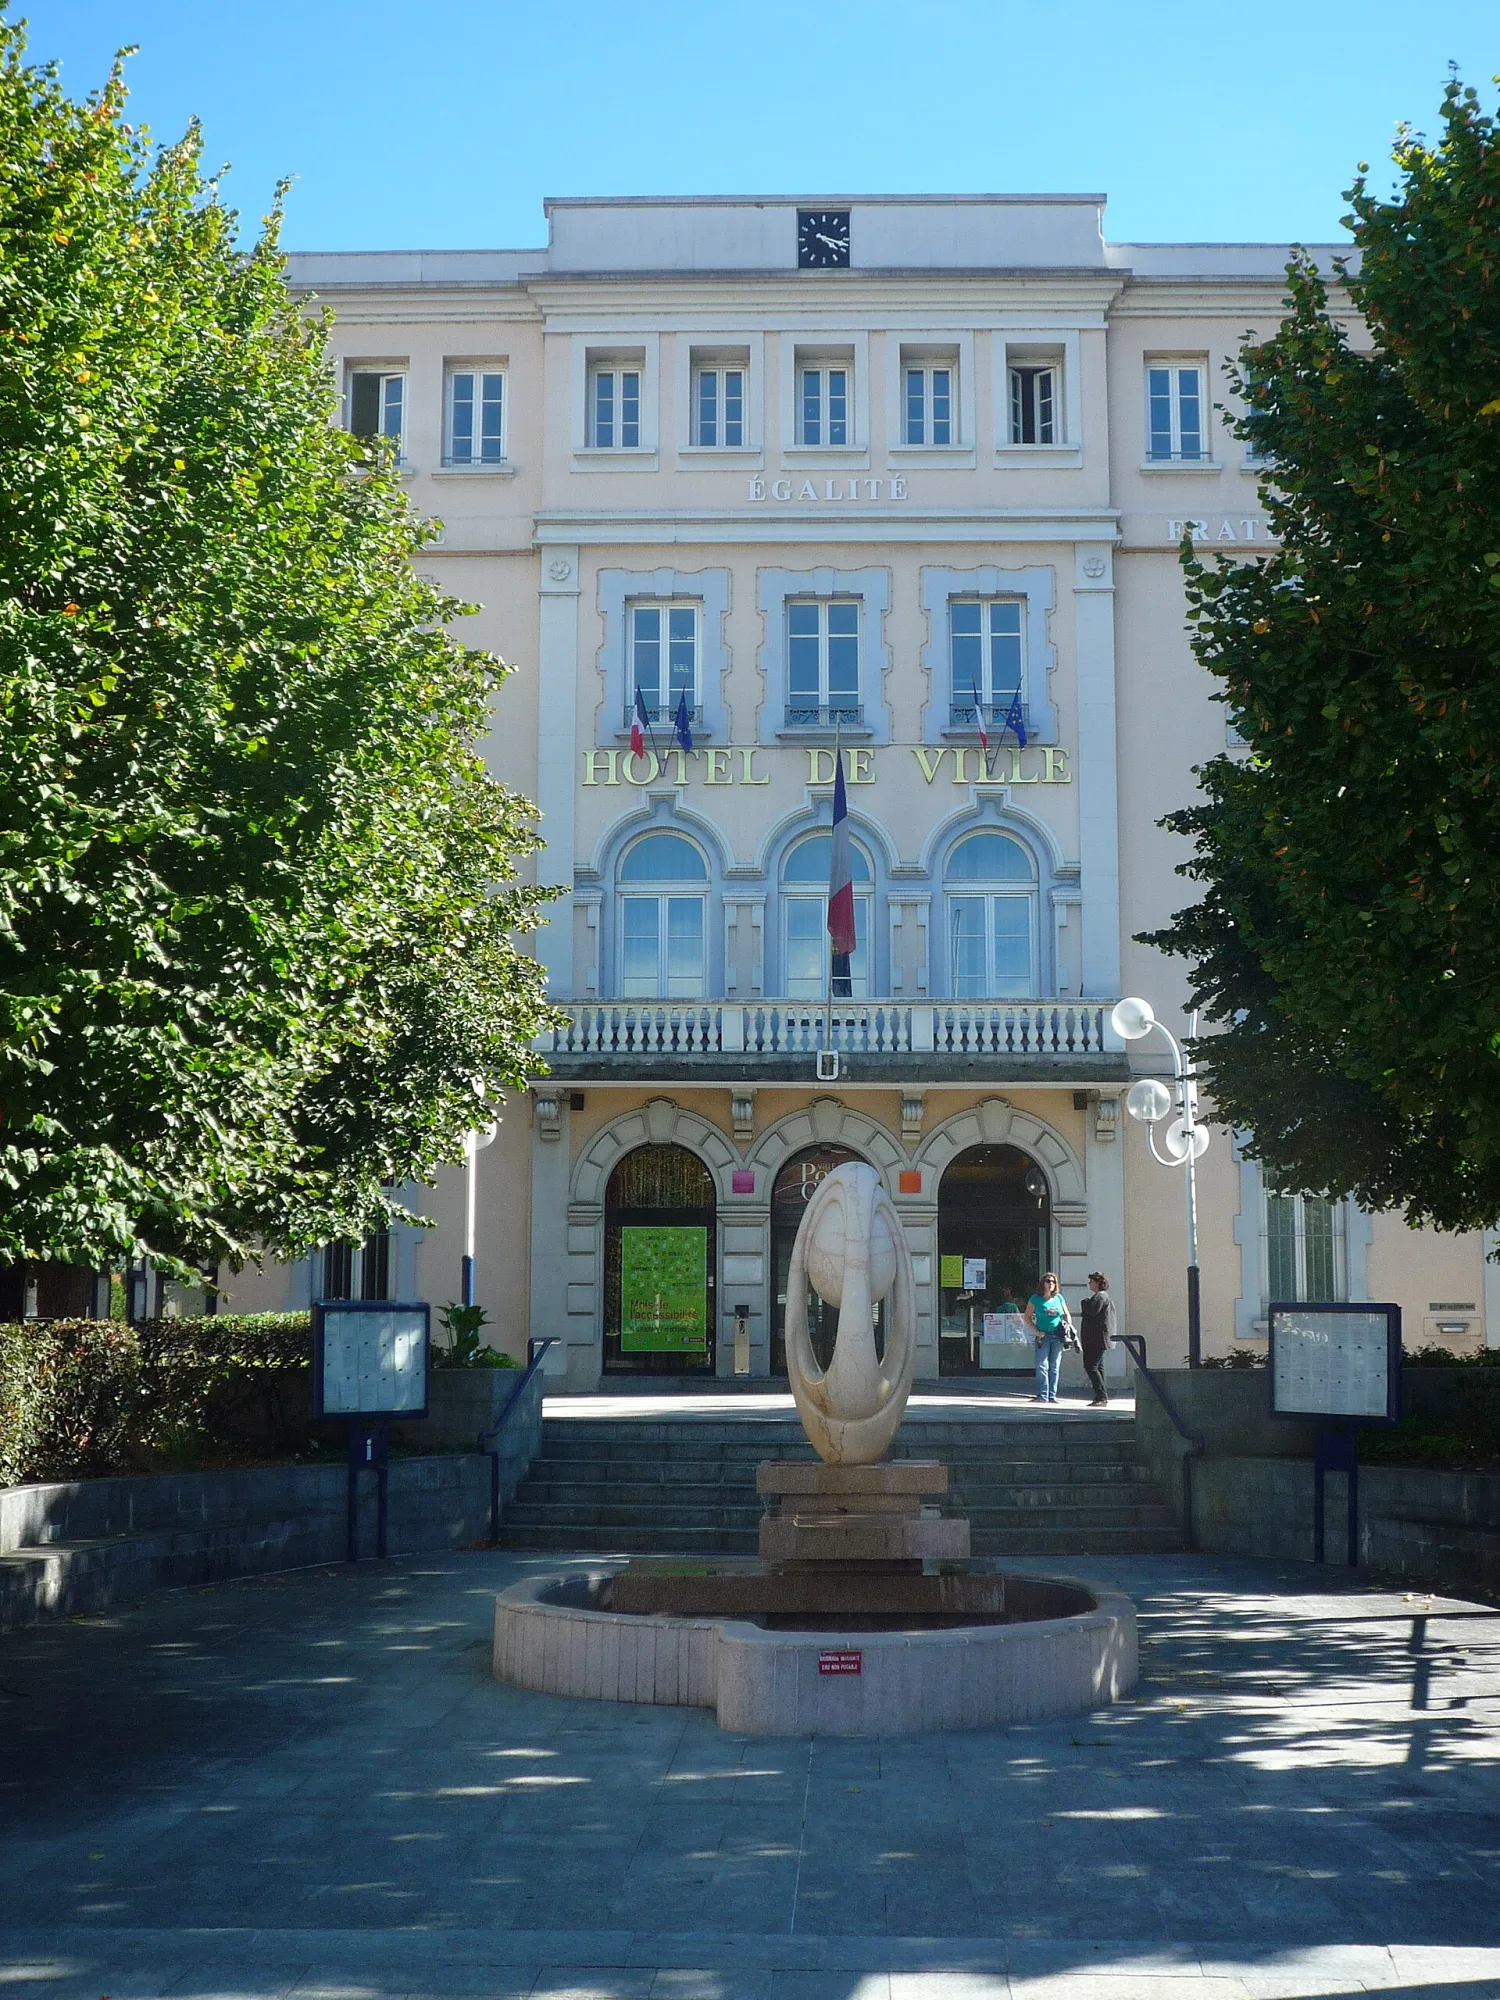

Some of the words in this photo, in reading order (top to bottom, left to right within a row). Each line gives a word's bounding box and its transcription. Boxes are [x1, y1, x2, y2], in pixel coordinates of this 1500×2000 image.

[748, 474, 908, 501] ÉGALITÉ
[582, 748, 770, 786] HOTEL
[806, 748, 876, 786] DE
[911, 748, 1072, 785] VILLE
